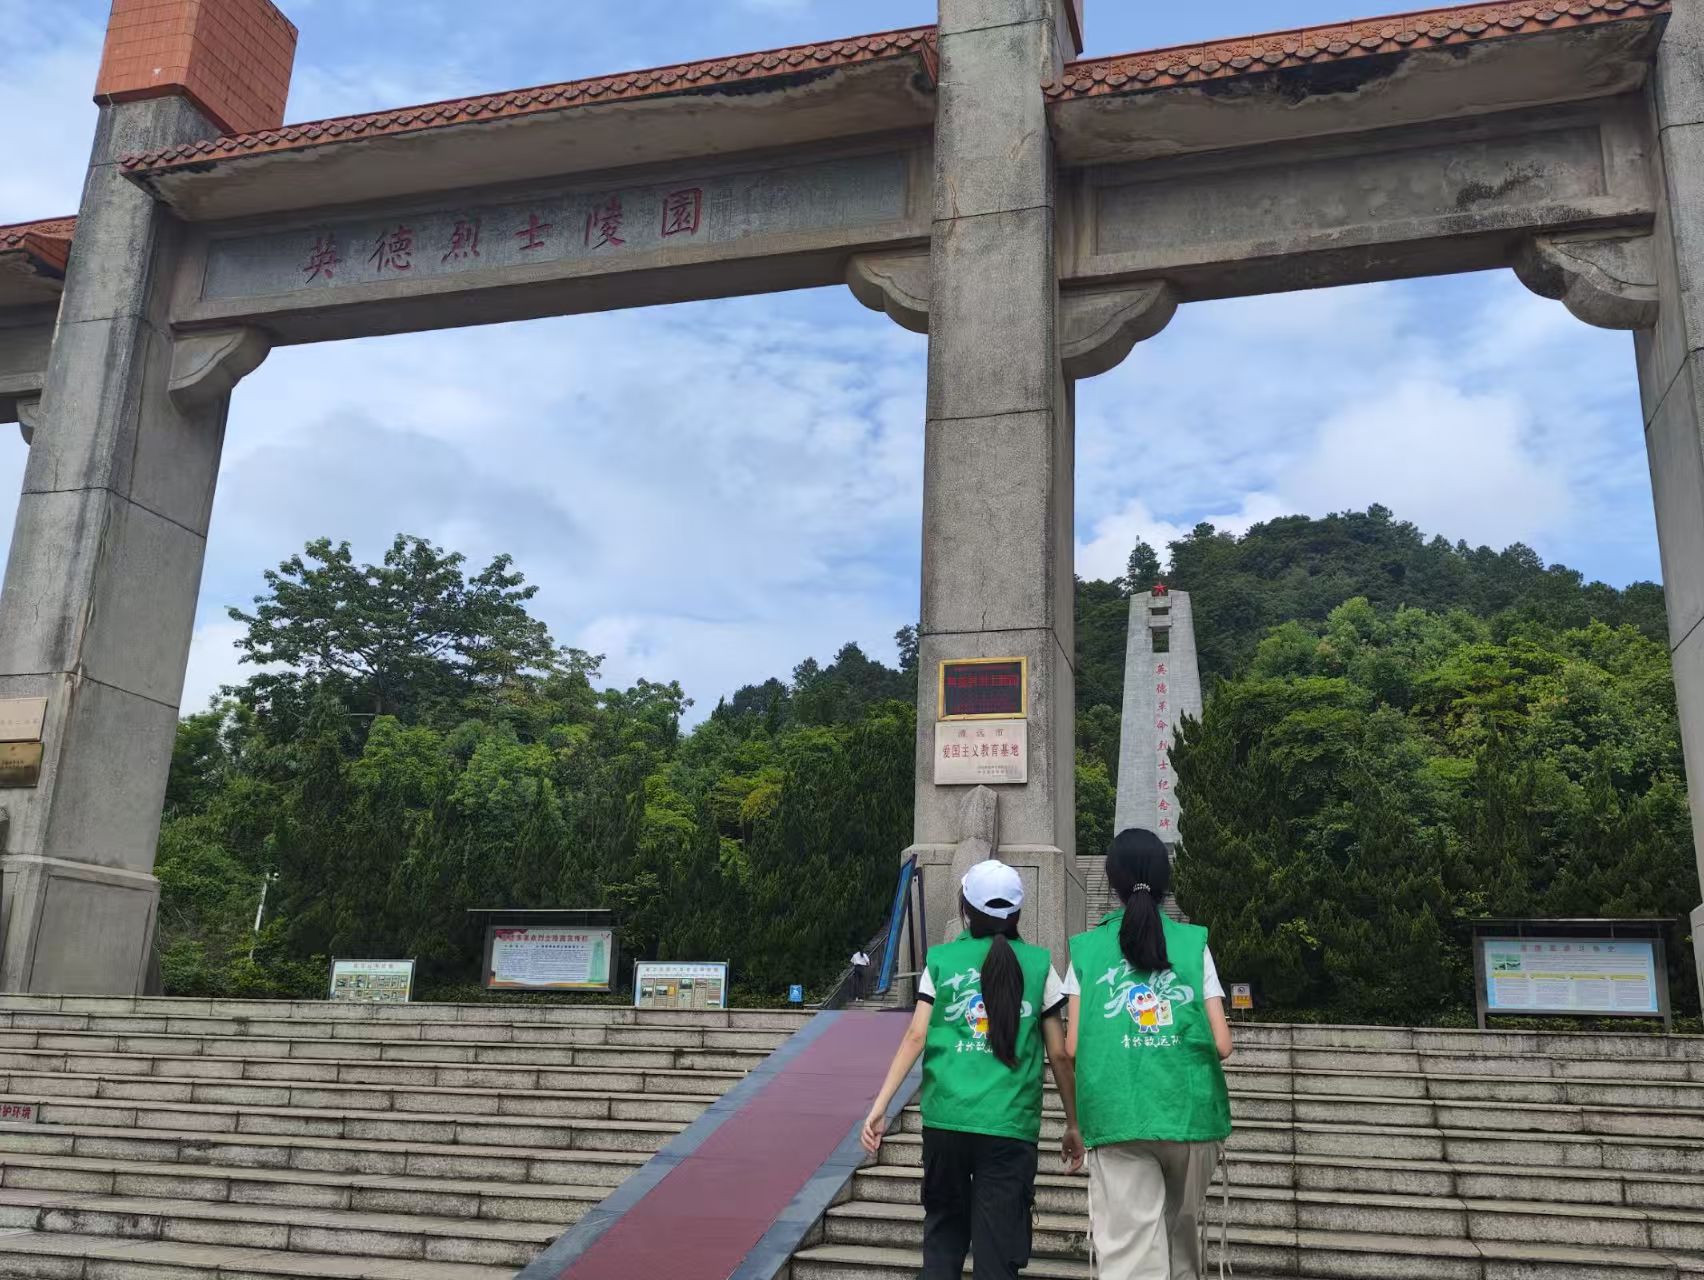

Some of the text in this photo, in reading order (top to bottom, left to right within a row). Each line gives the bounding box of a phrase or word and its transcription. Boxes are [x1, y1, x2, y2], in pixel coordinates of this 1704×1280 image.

[943, 743, 1020, 758] 爱国主义教育基地
[1154, 663, 1171, 831] 英德革命烈士纪念碑
[0, 1104, 31, 1119] 护环境
